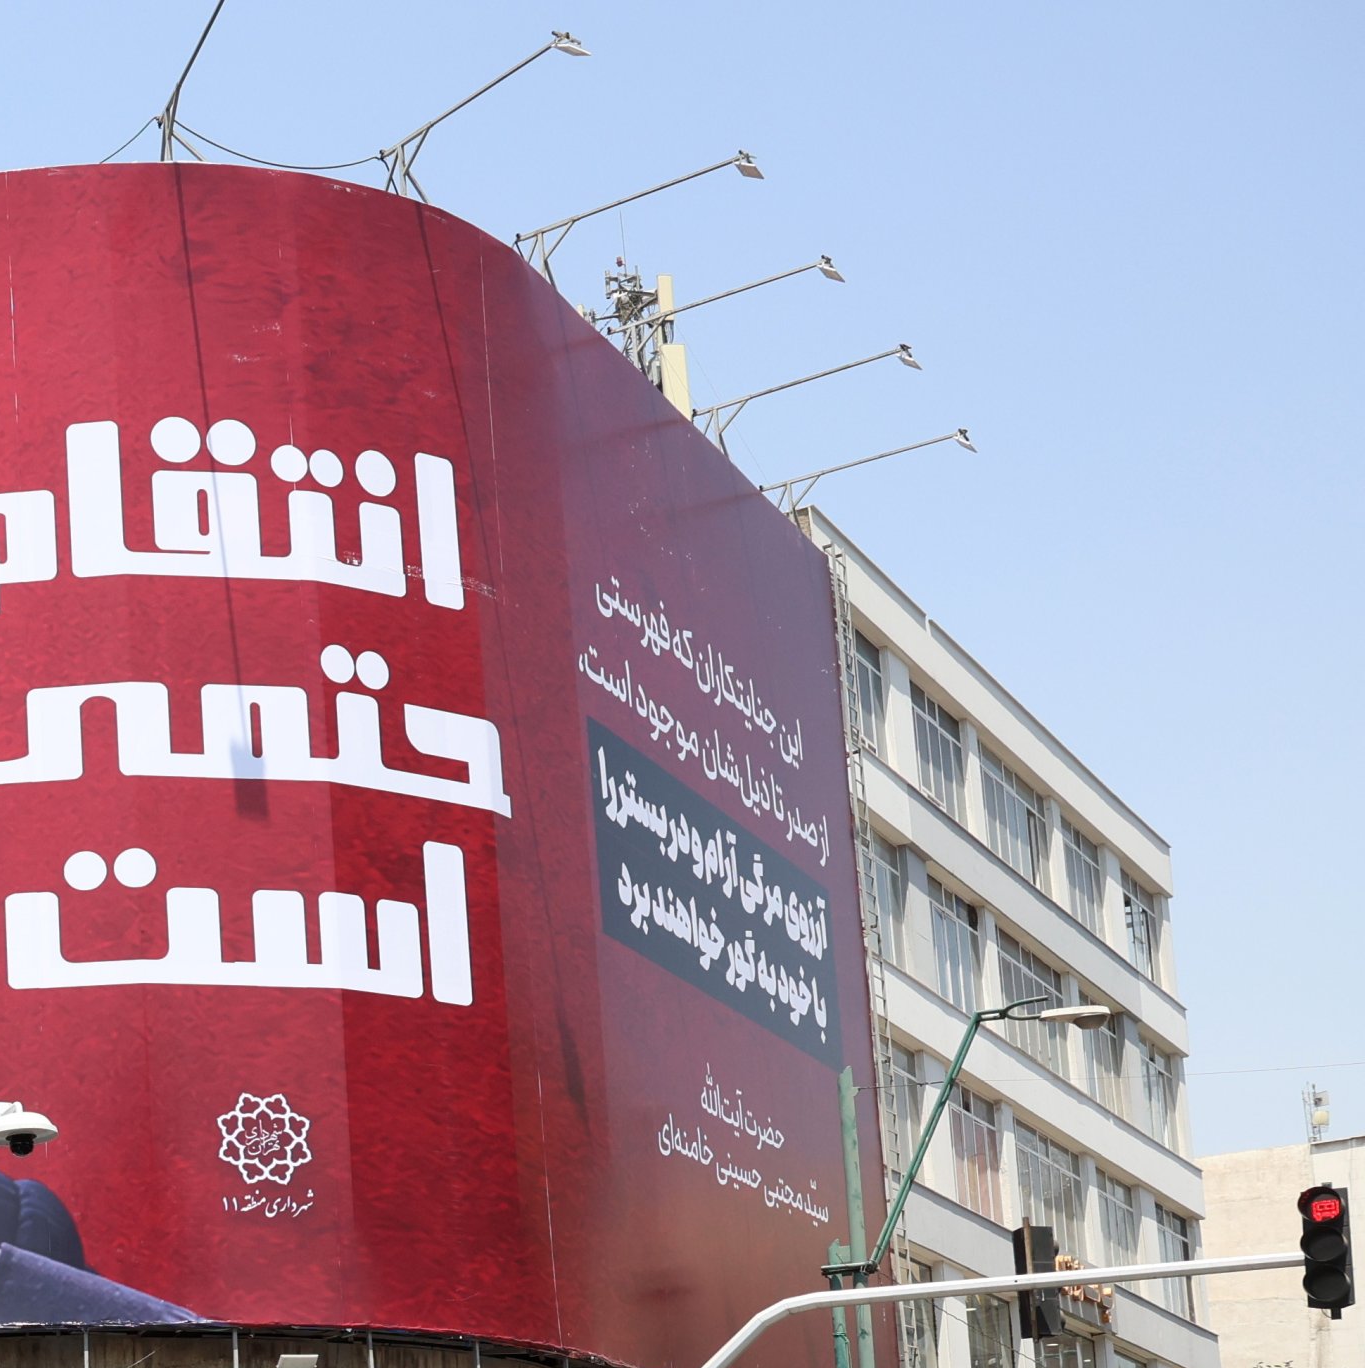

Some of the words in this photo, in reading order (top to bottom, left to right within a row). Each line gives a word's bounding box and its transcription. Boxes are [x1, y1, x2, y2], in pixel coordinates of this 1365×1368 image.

[596, 576, 671, 656] فهرستی
[673, 629, 693, 669] که
[695, 644, 777, 748] جنایتکاران
[779, 719, 803, 769] این
[598, 746, 618, 822] را
[617, 770, 667, 856] بستر
[668, 813, 690, 862] در
[692, 827, 703, 880] و
[705, 828, 738, 898] آرام
[5, 840, 473, 1006] است
[618, 862, 651, 935] برد
[652, 887, 725, 971] خواهند
[784, 891, 827, 960] آرزوی
[725, 930, 755, 993] گور
[757, 951, 777, 1012] به
[777, 966, 812, 1026] خود
[812, 976, 827, 1044] با
